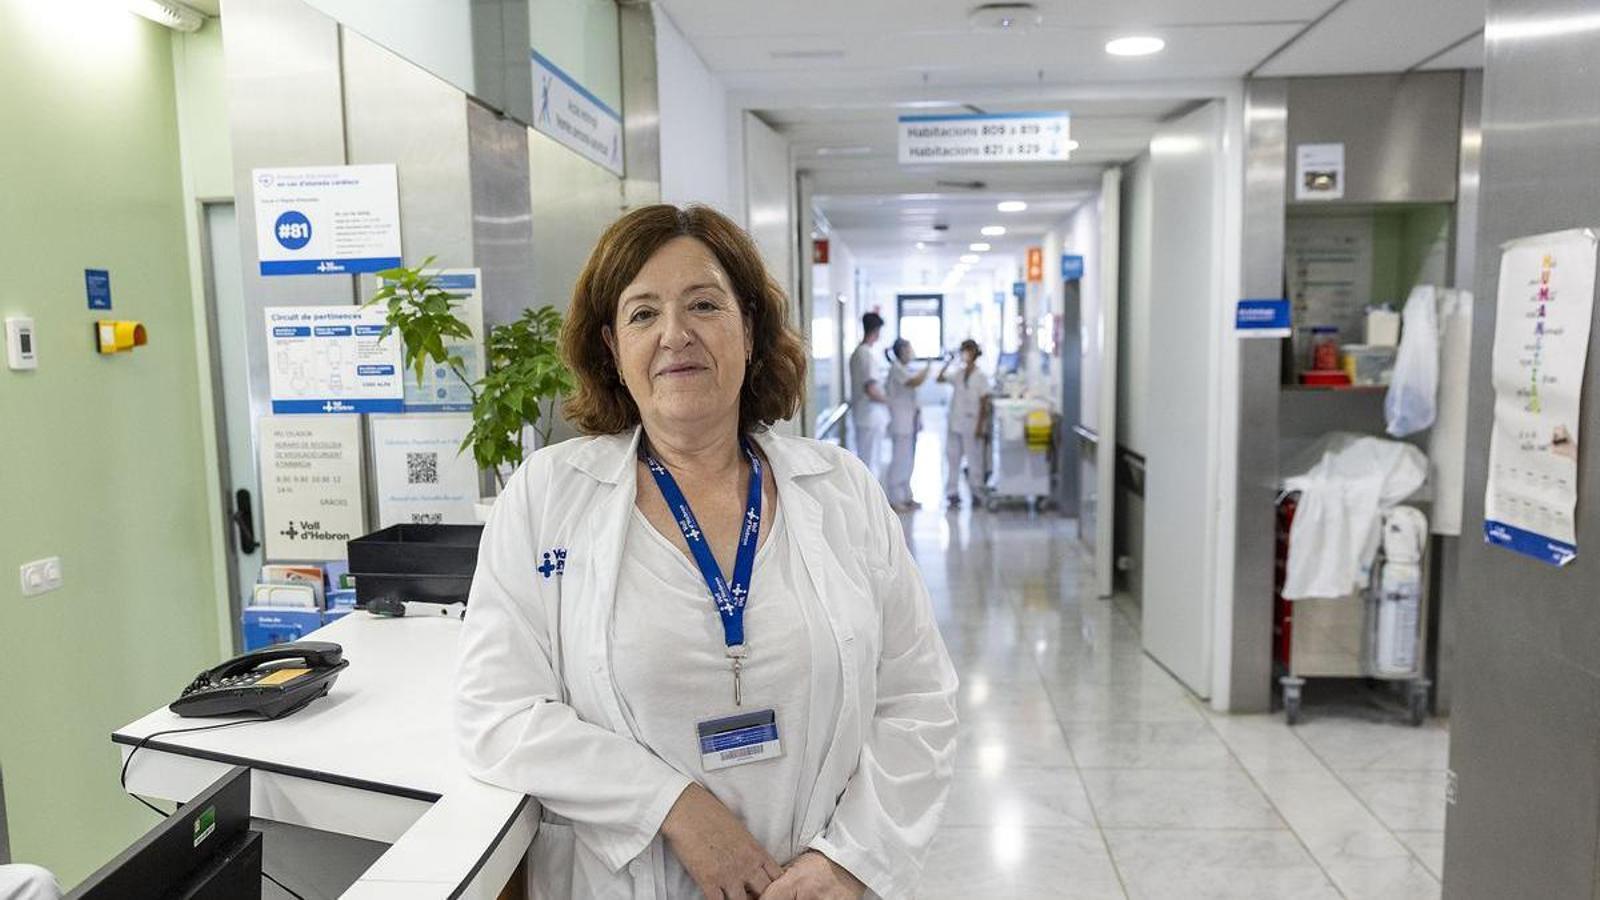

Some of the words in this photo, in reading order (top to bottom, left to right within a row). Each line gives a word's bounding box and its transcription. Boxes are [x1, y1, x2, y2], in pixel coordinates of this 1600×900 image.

[907, 126, 978, 137] Habitacions
[909, 145, 980, 157] Habitacions
[278, 223, 309, 239] #81
[272, 313, 299, 321] Circuit
[314, 311, 362, 322] pertinences
[300, 521, 320, 530] Vall
[300, 531, 350, 540] d'Hebron
